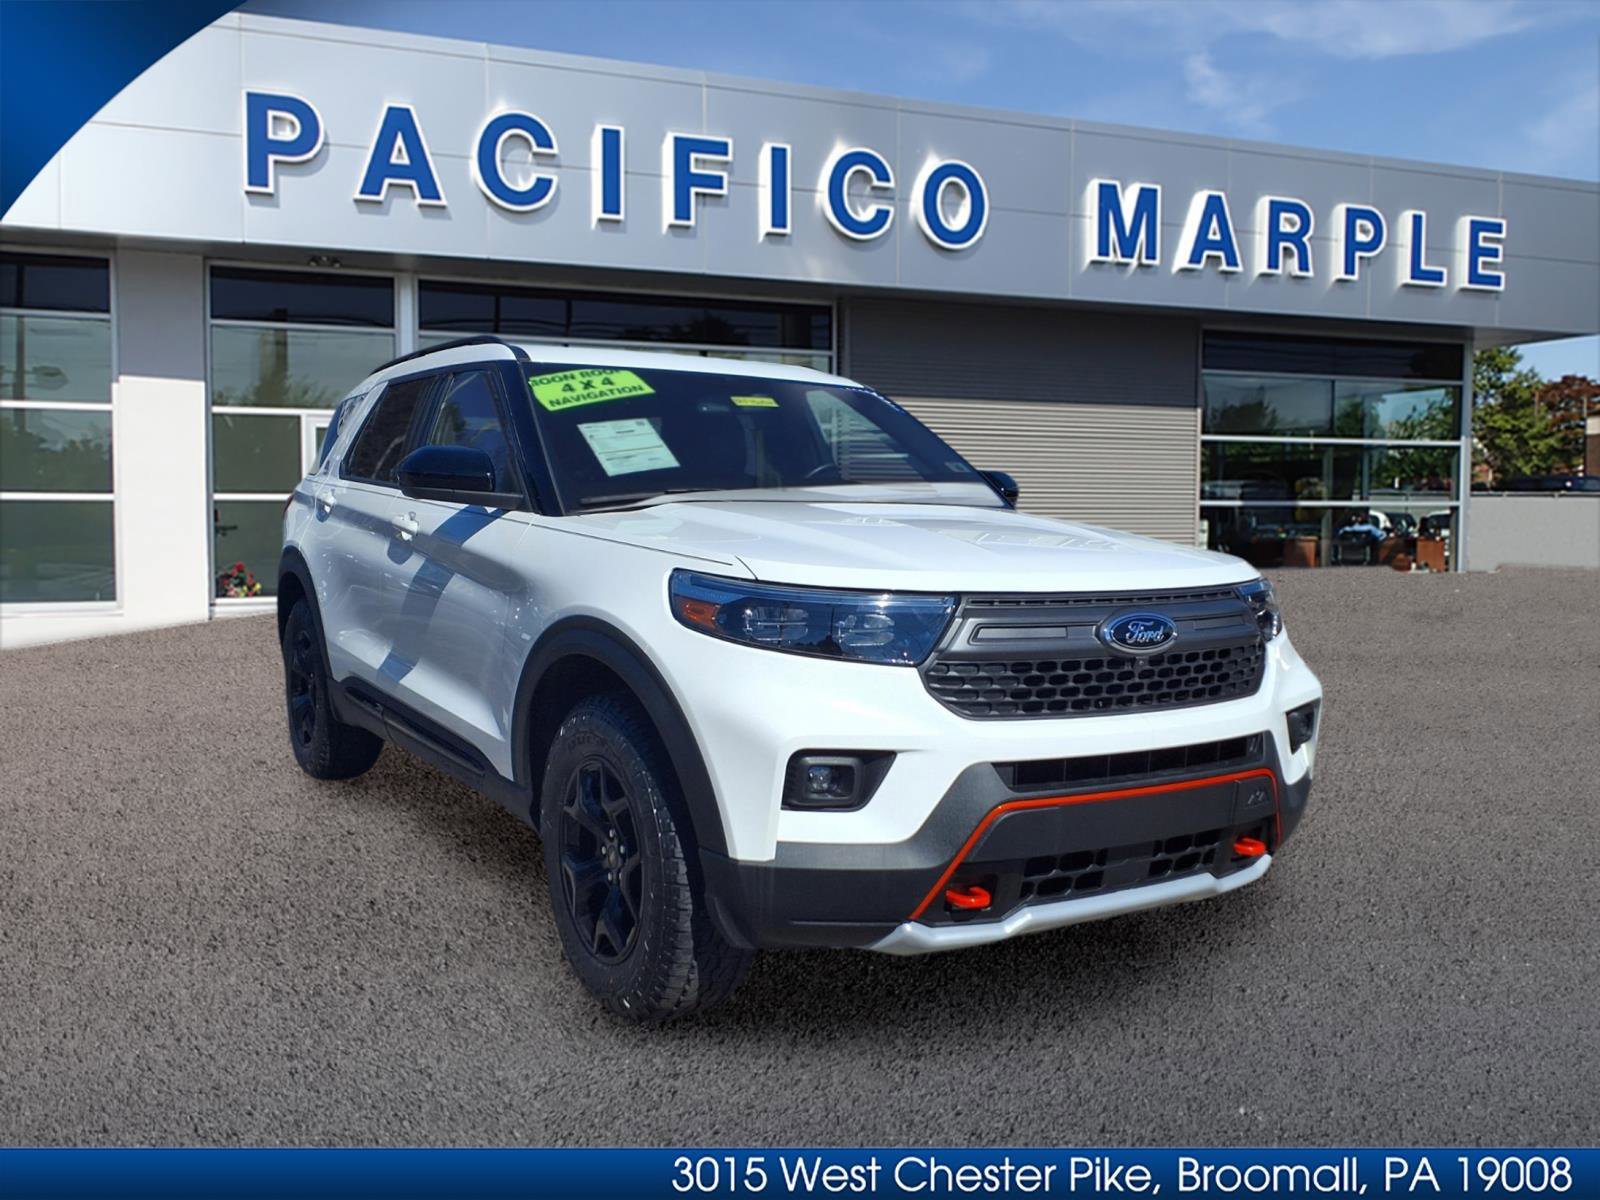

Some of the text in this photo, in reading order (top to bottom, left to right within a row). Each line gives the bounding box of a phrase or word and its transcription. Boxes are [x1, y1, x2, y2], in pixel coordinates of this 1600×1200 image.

[243, 89, 1507, 292] PACIFICO MARPLE
[561, 383, 576, 393] 4
[601, 376, 615, 386] 4
[579, 369, 620, 379] ROO
[548, 385, 644, 408] NAVIGATION
[1126, 621, 1164, 643] Ford
